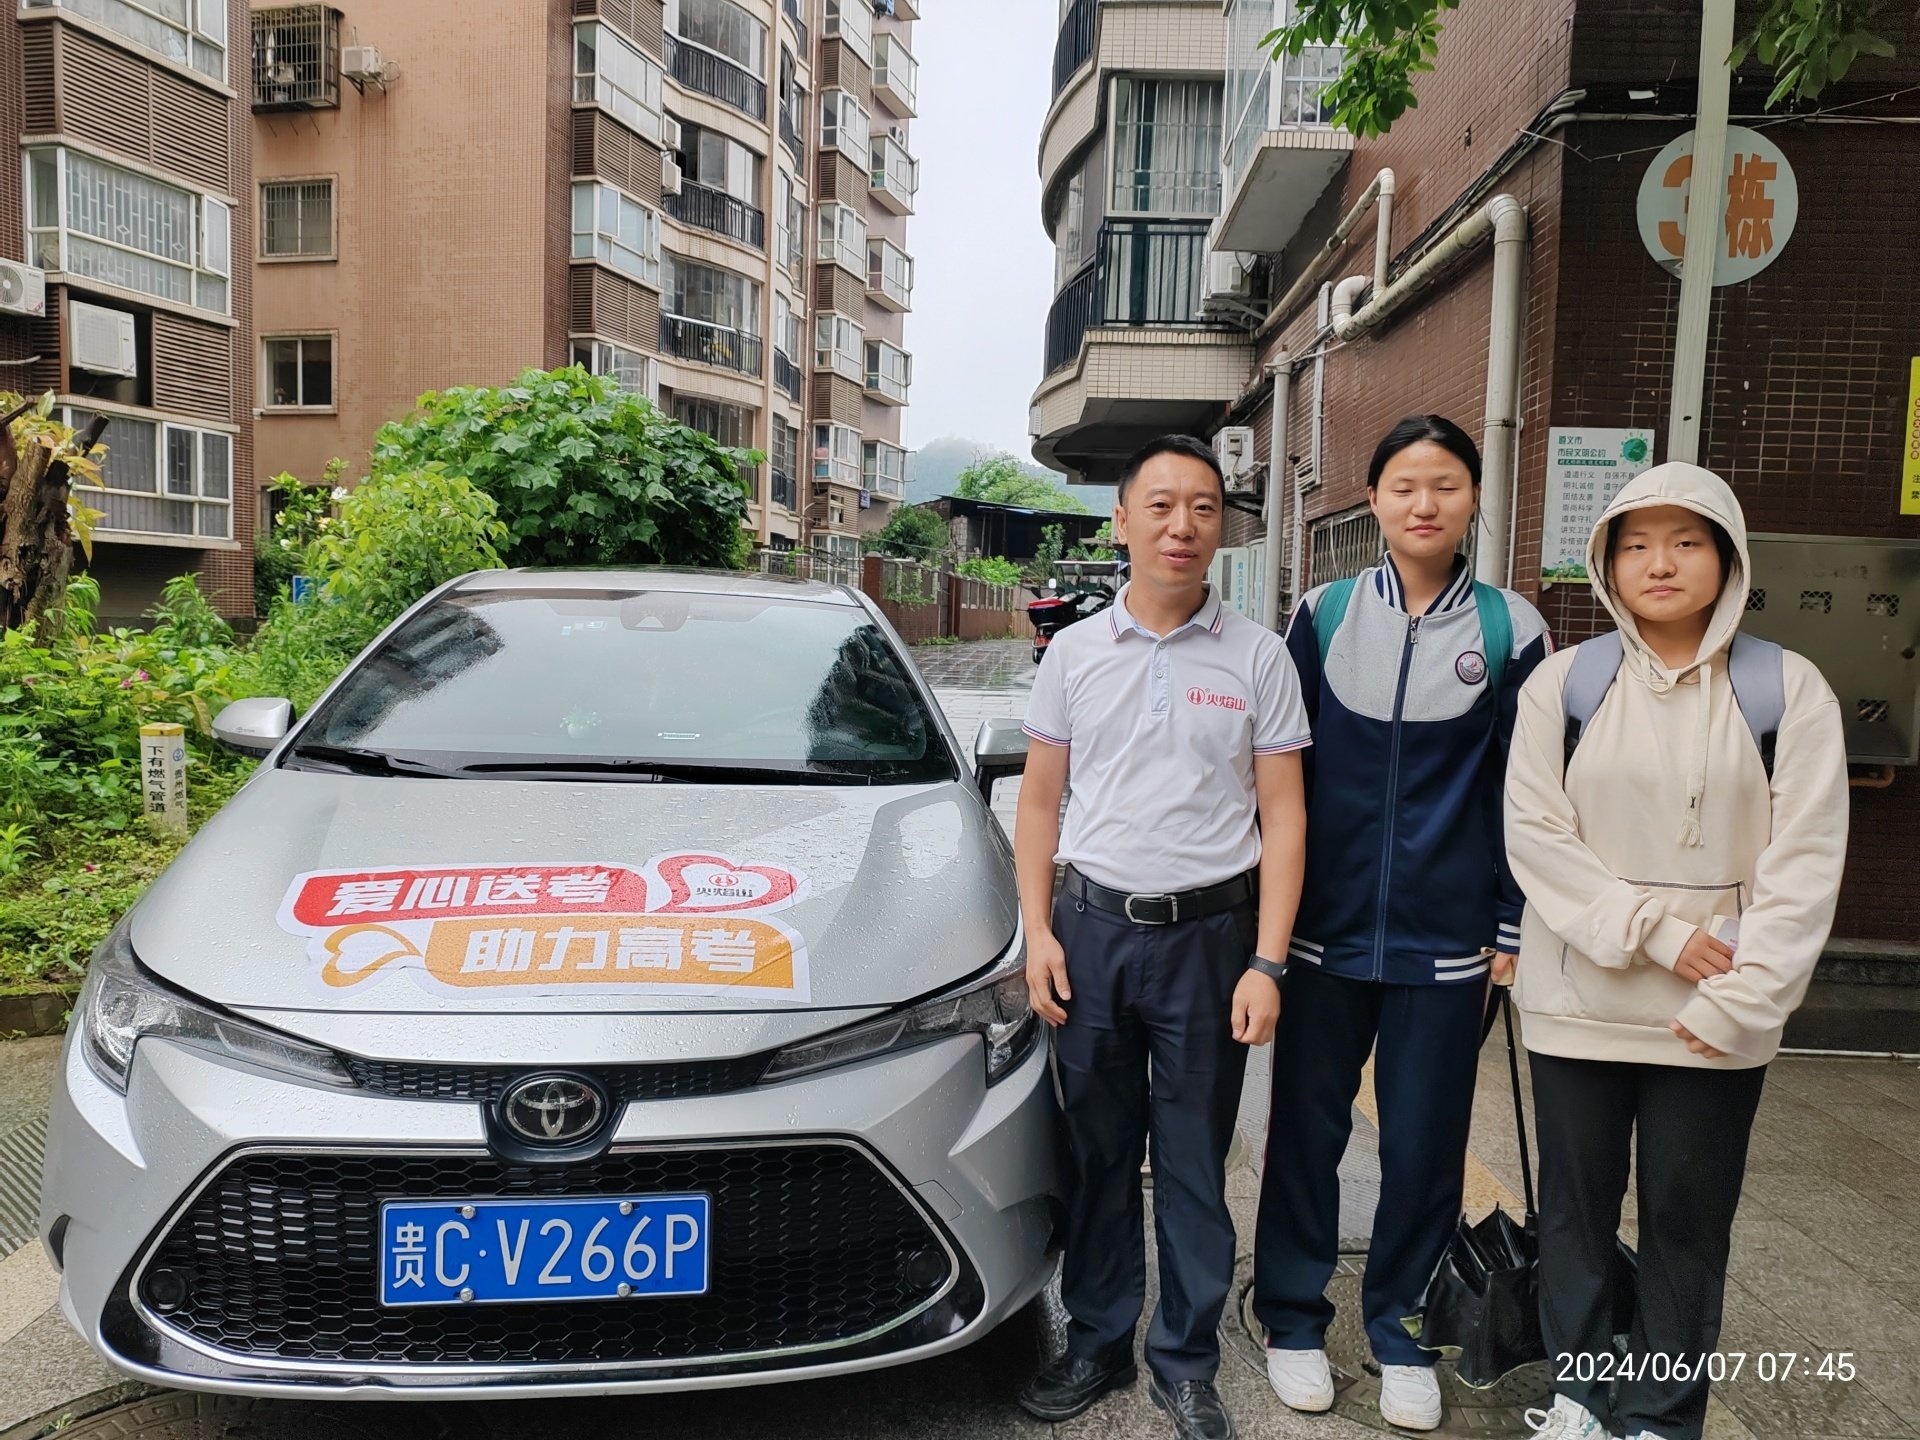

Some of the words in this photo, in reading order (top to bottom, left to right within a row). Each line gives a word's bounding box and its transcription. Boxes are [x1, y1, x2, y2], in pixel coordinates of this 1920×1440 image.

[1558, 436, 1583, 445] 遵义市
[1557, 448, 1607, 458] 市民文明公约
[1563, 482, 1595, 490] 明礼诚信
[1562, 493, 1593, 501] 团结友善
[1562, 504, 1593, 512] 崇尚科学
[1561, 526, 1591, 534] 讲究卫生
[1206, 694, 1246, 711] 火焰山
[146, 745, 167, 813] 下有燃气管道
[326, 873, 609, 914] 爱心送考
[696, 887, 753, 898] 火焰山
[460, 928, 756, 973] 助力高考
